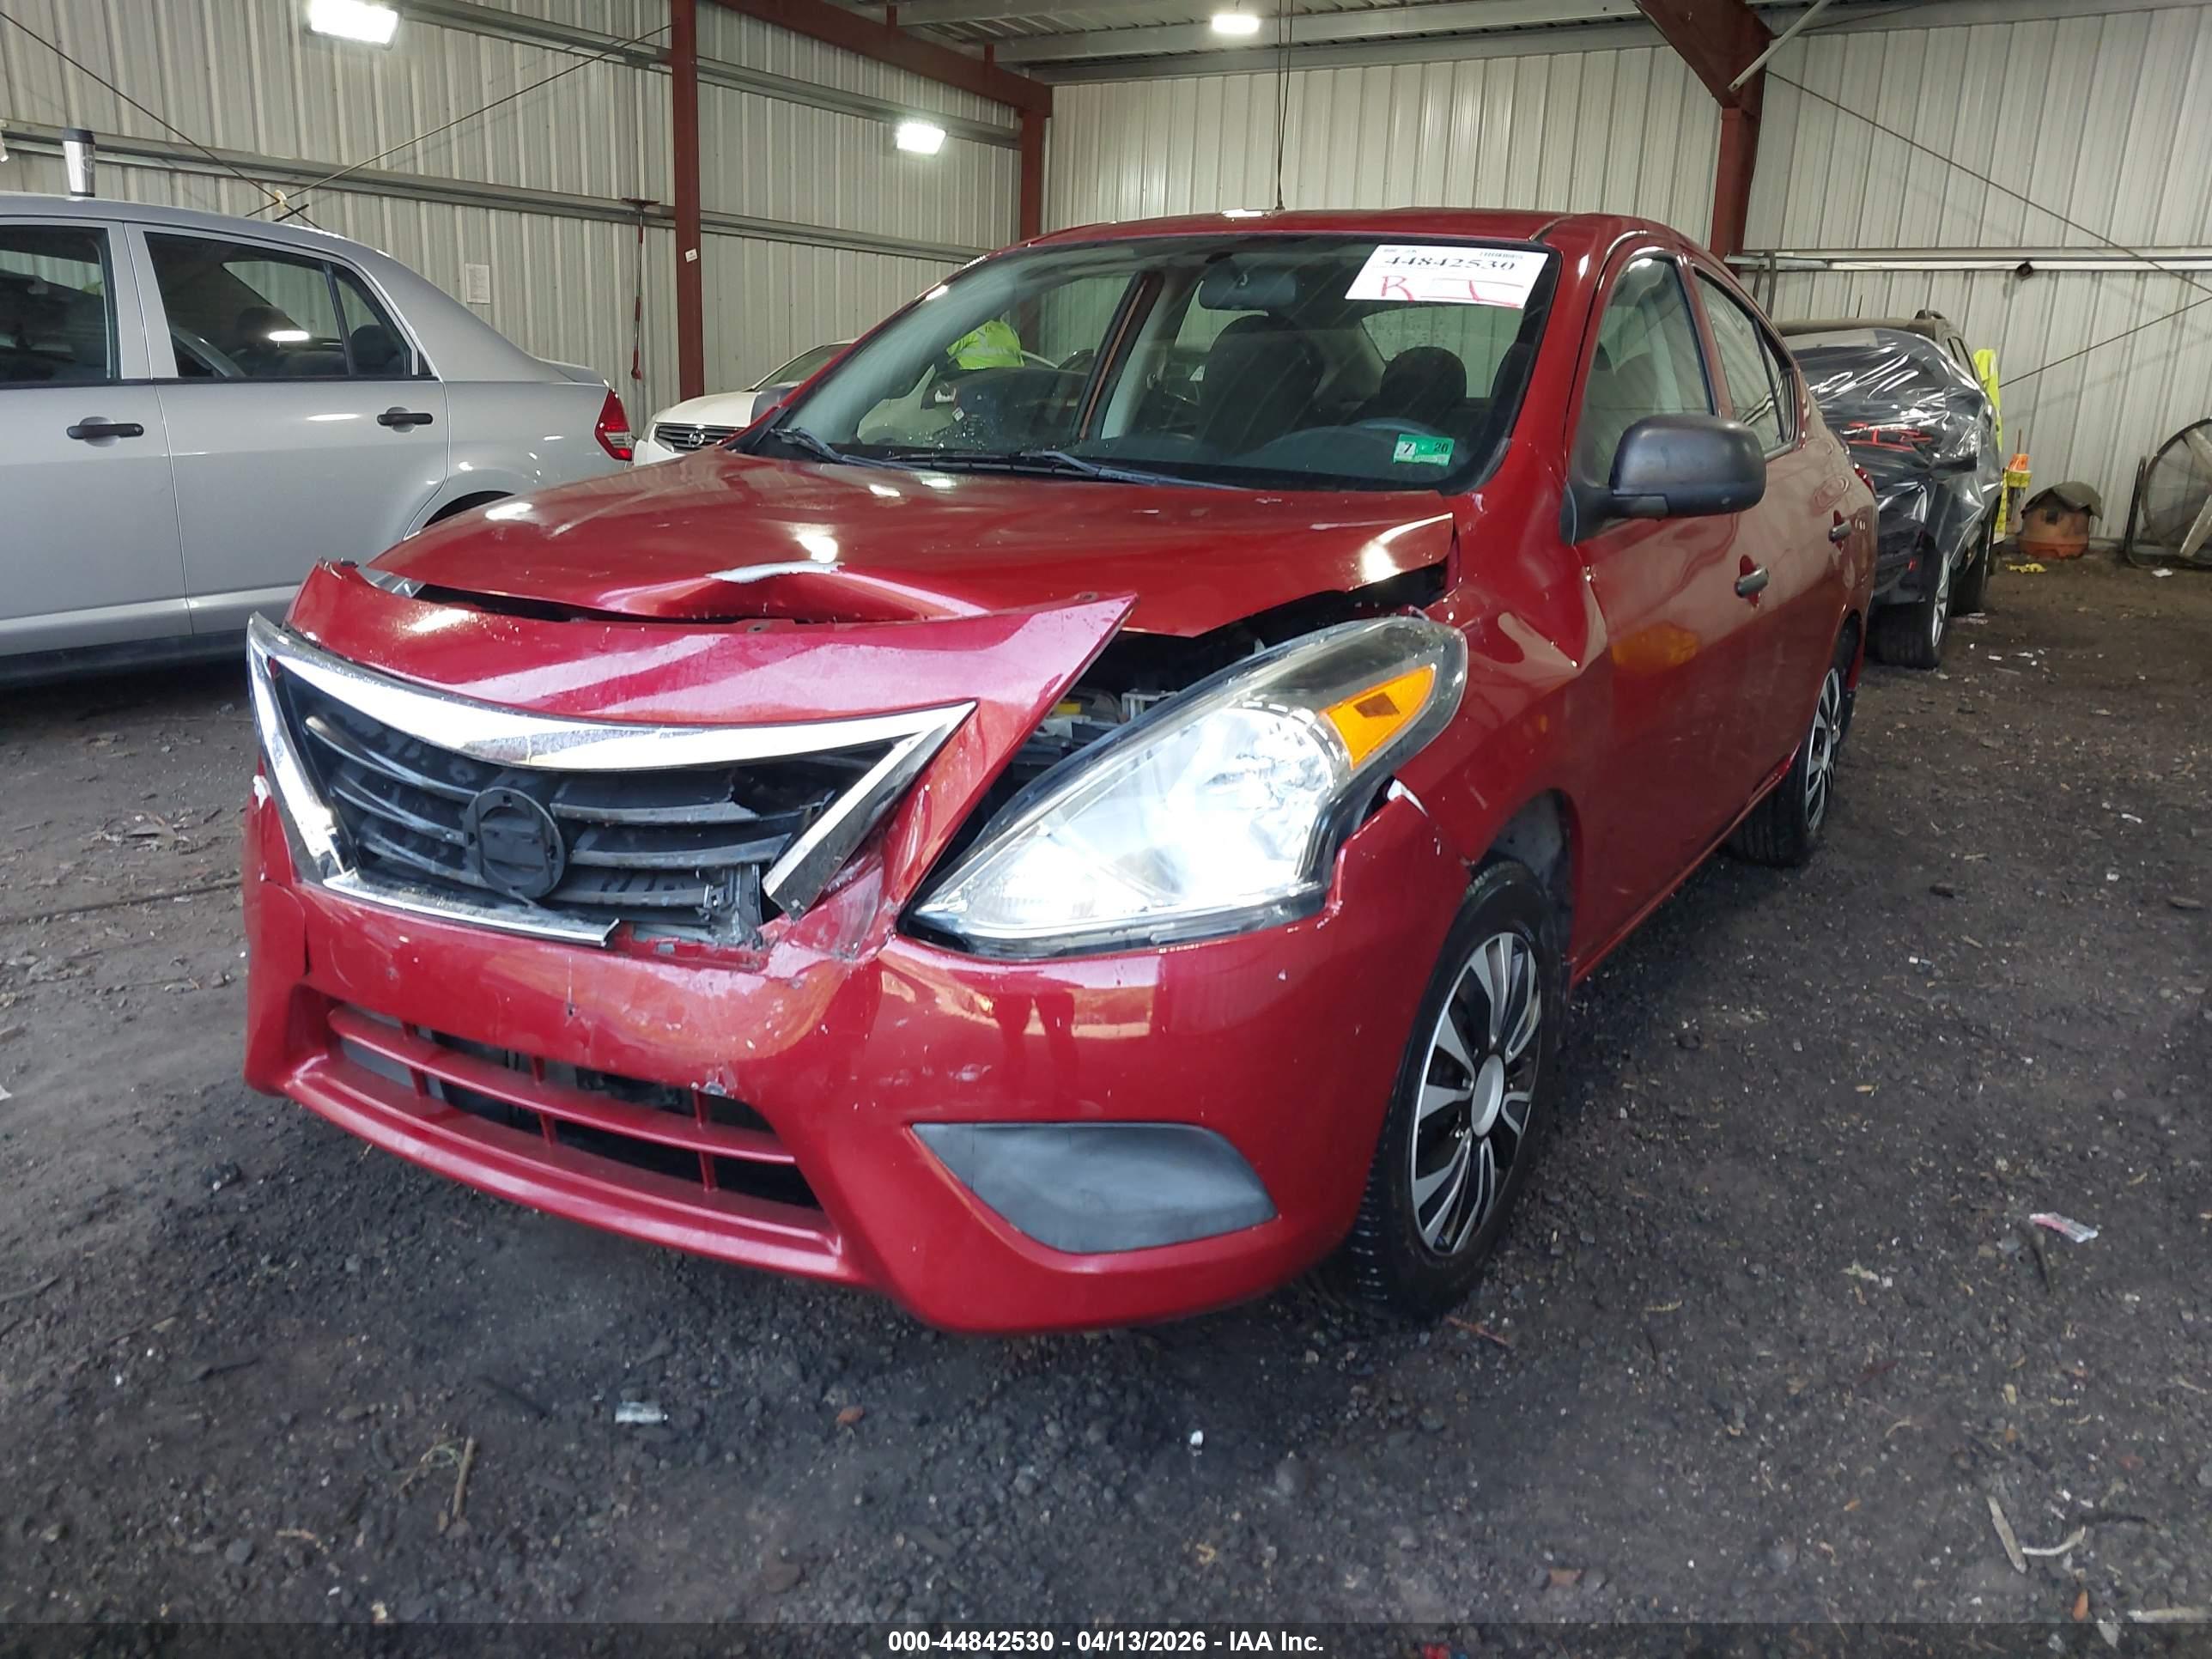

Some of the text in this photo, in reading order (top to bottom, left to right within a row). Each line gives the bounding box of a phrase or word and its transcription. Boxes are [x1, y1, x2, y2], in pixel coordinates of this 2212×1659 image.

[1385, 255, 1516, 270] 44842530
[1381, 275, 1416, 301] R
[1403, 442, 1413, 454] 7
